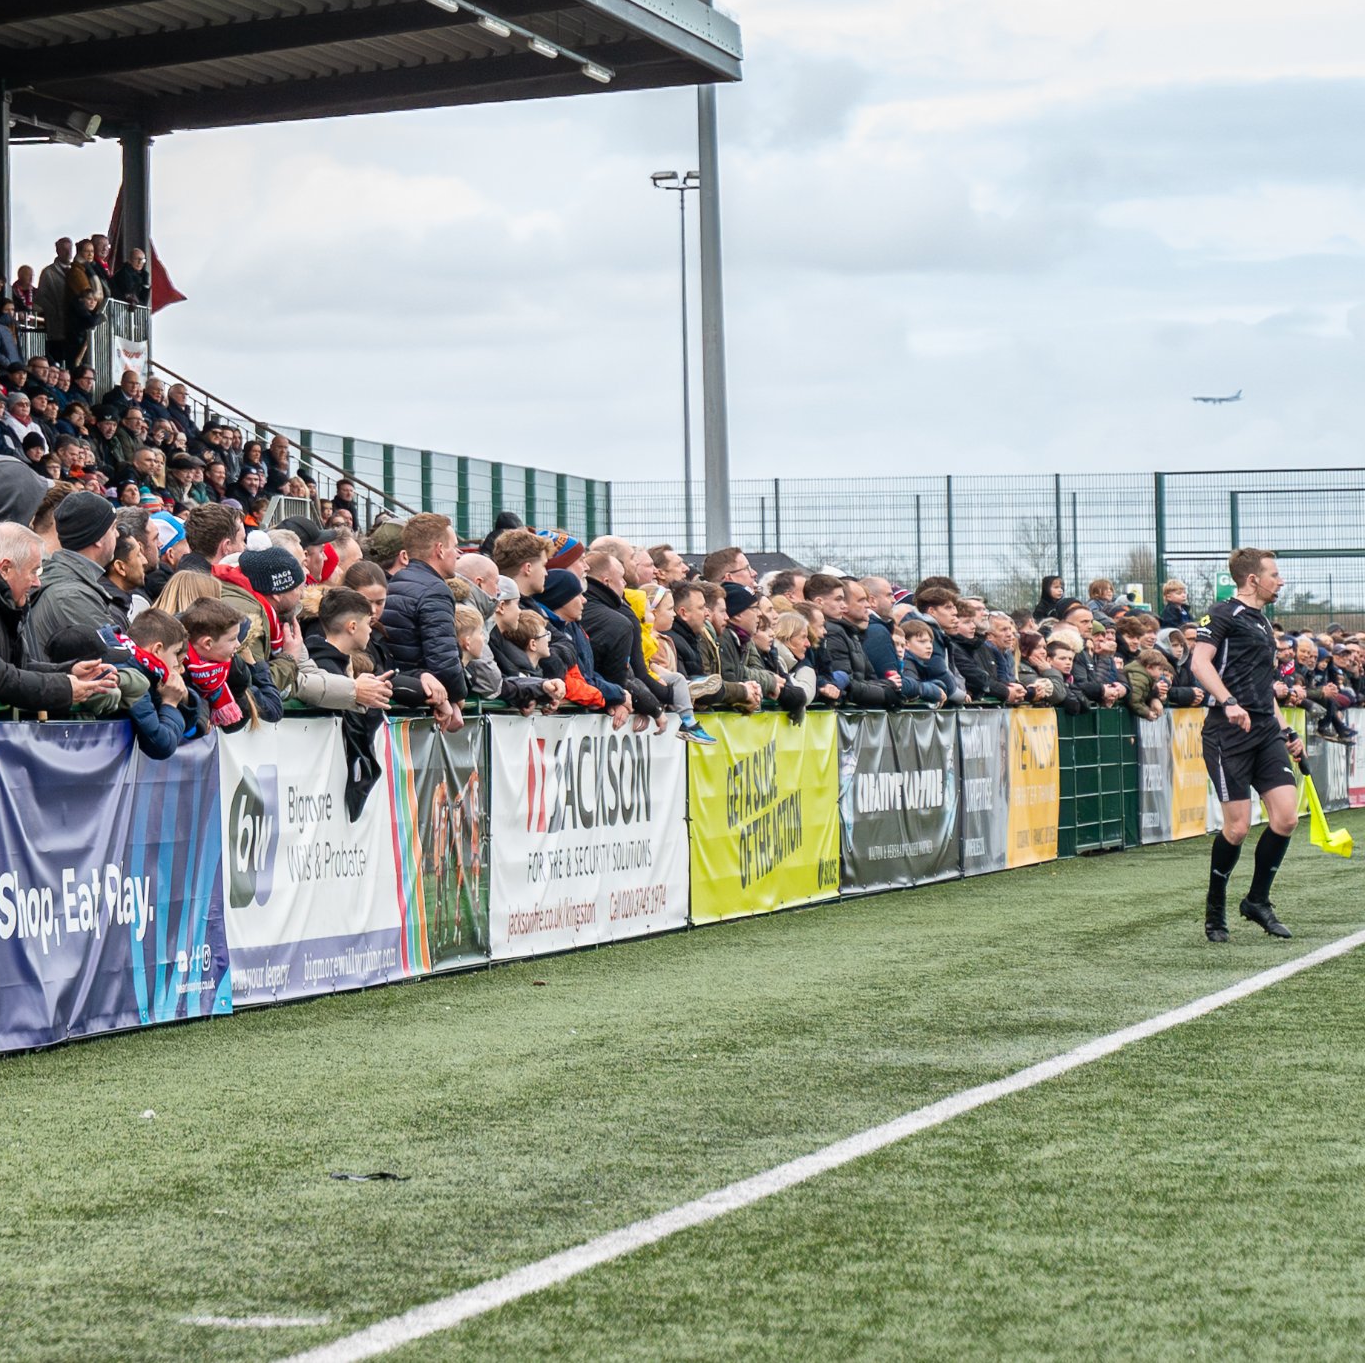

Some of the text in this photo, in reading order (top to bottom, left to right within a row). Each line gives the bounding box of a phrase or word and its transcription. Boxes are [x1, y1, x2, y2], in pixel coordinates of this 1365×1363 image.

[271, 570, 291, 581] NAGS
[272, 576, 293, 587] HEAD
[547, 734, 651, 834] JACKSON
[727, 739, 778, 830] GET A SLICE
[236, 794, 273, 874] bw
[739, 788, 803, 890] OF THE ACTION
[314, 842, 321, 881] &
[324, 841, 367, 879] Probate
[527, 852, 546, 884] FOR
[566, 848, 572, 877] &
[574, 843, 611, 877] SECURITY
[612, 839, 653, 872] SOLUTIONS
[105, 862, 155, 942] Play.
[621, 888, 635, 919] 020
[651, 883, 667, 914] 1974
[265, 959, 291, 994] legacy.
